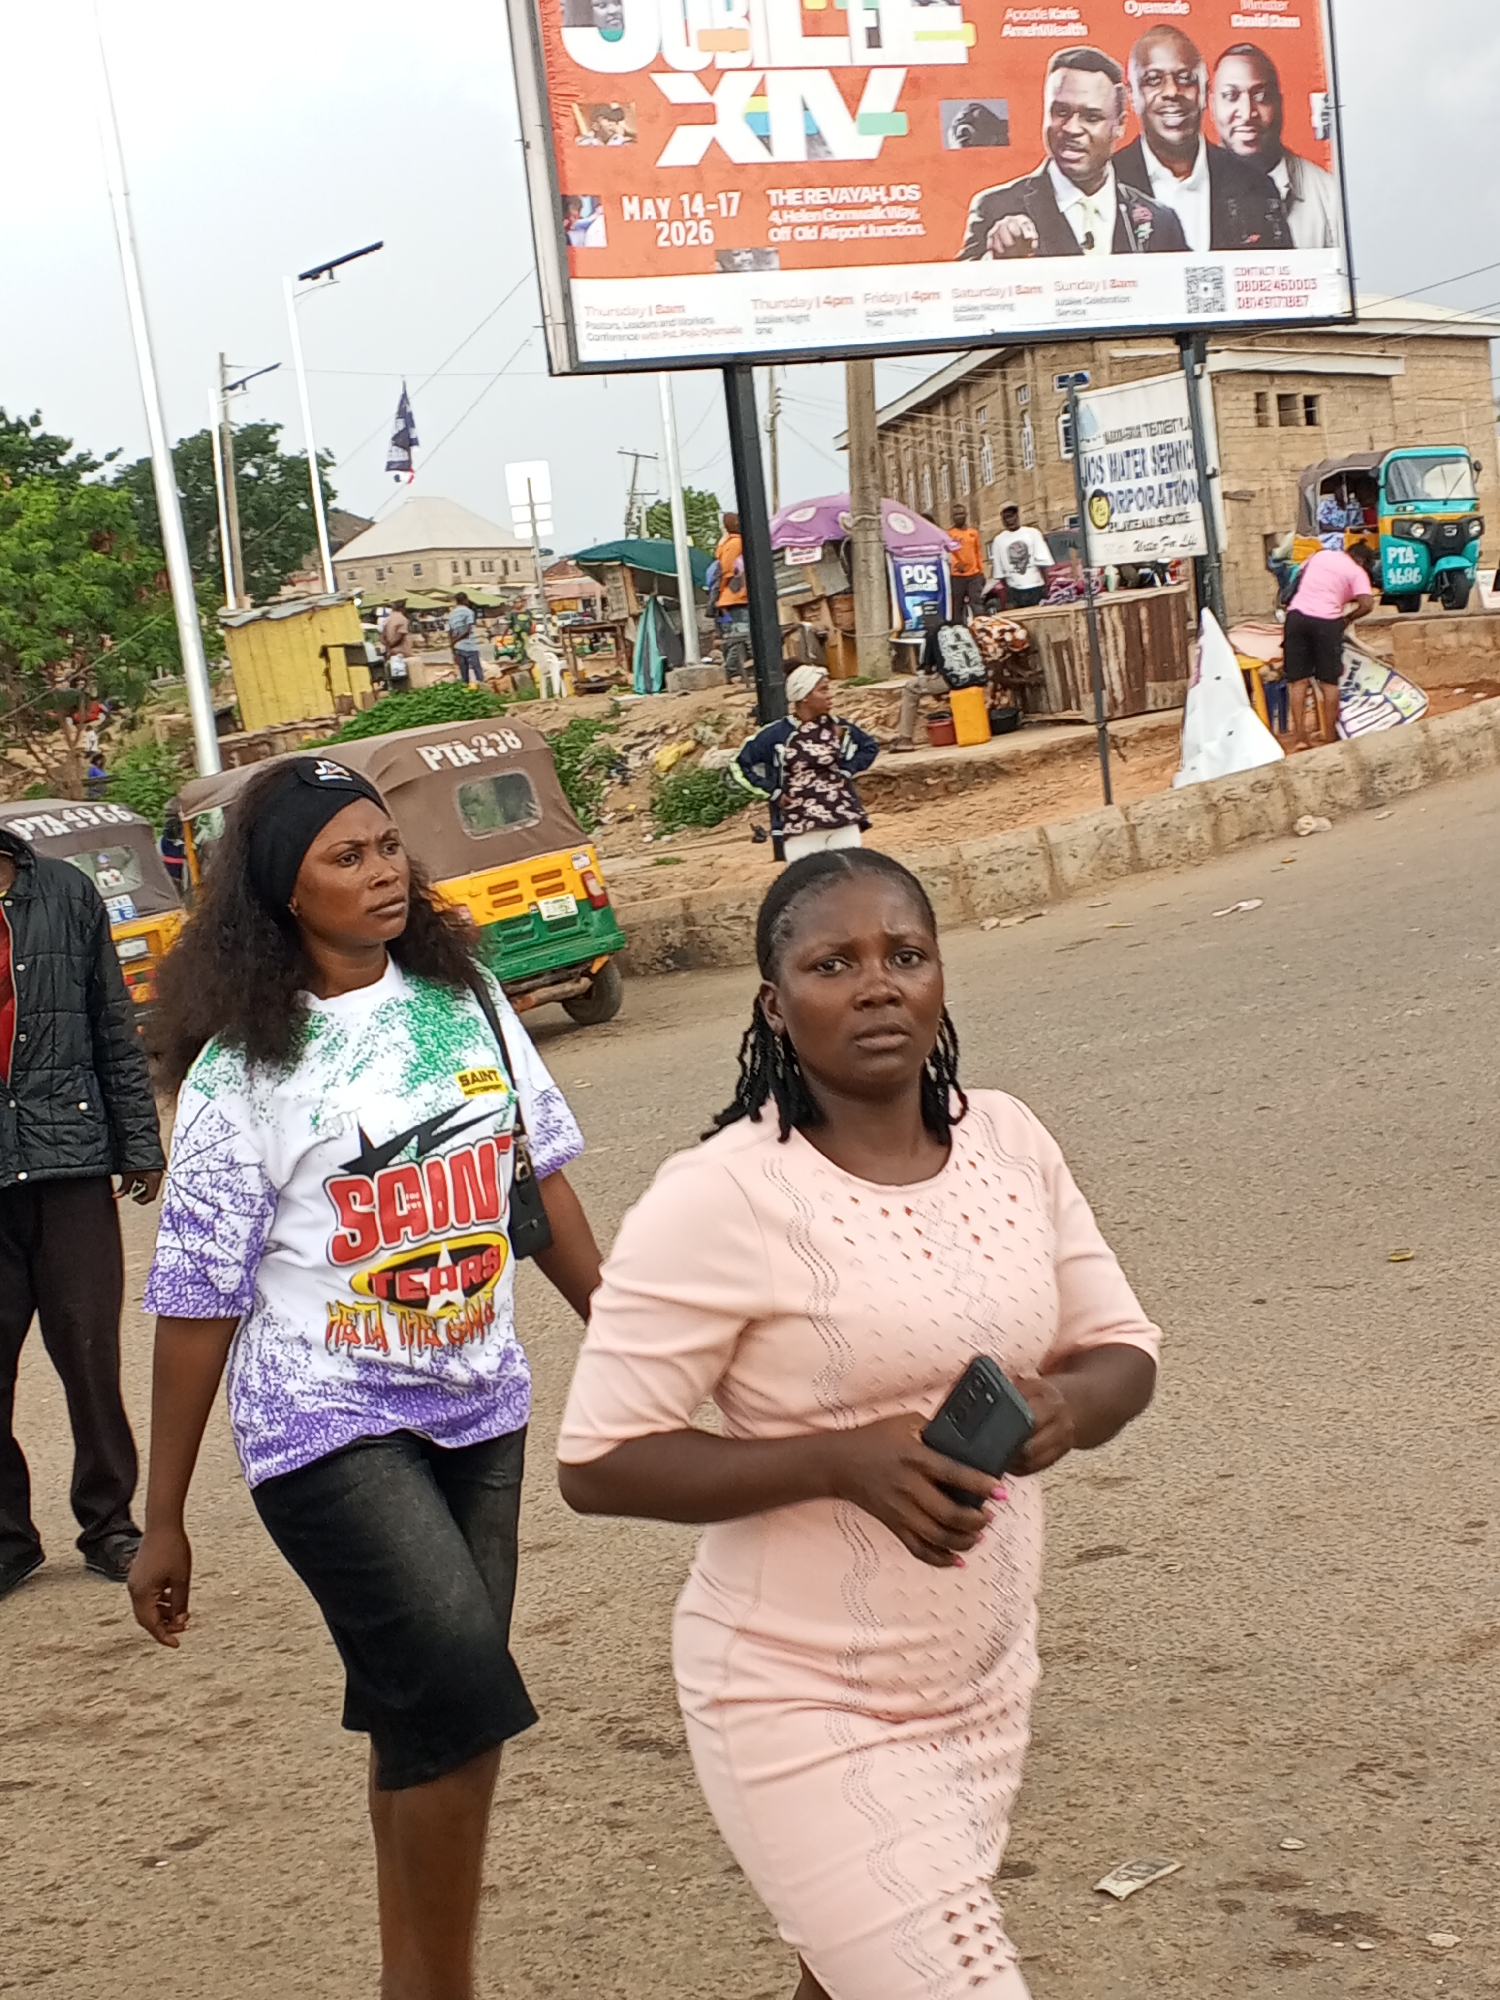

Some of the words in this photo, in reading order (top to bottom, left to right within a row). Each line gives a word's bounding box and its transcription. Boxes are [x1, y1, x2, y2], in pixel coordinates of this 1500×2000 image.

[649, 67, 908, 167] XIV
[766, 187, 806, 206] THE
[621, 194, 671, 221] MAY
[680, 192, 741, 219] 14-17
[656, 220, 714, 247] 2026
[768, 226, 792, 242] Off
[793, 226, 817, 241] Old
[952, 286, 1008, 299] Saturday
[1054, 280, 1099, 292] Sunday
[751, 297, 812, 310] Thursday
[864, 293, 900, 305] Friday
[584, 305, 647, 318] Thursday
[900, 565, 938, 585] POS
[458, 1070, 499, 1087] SAINT
[368, 1244, 501, 1300] TEARS
